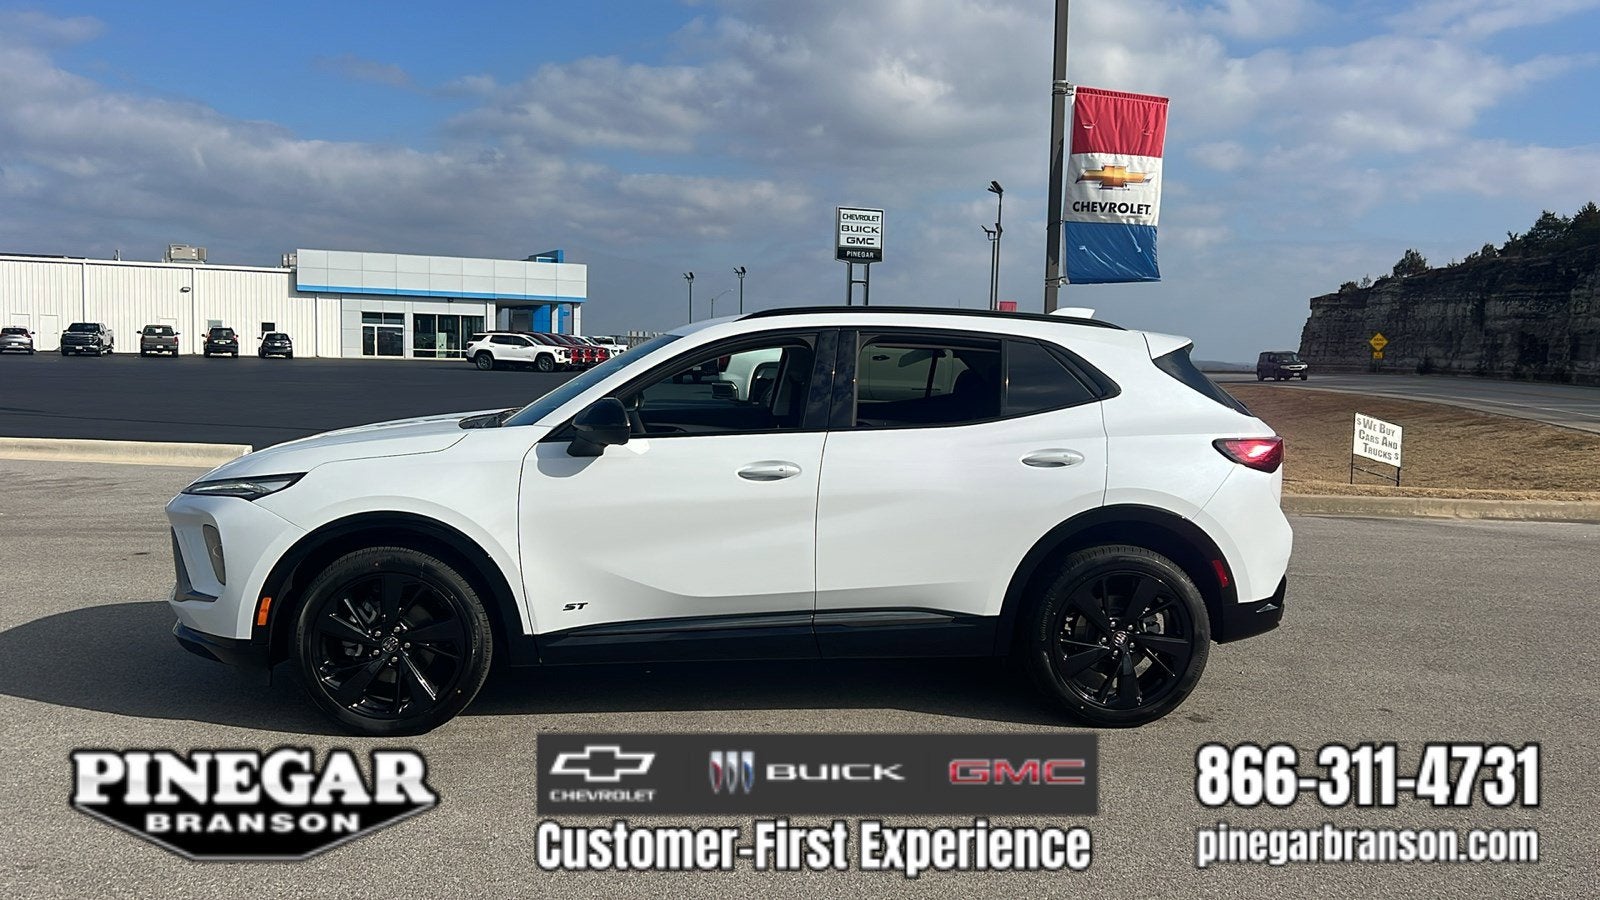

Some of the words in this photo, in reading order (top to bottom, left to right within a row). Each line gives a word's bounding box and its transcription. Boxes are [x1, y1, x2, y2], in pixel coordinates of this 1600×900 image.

[1072, 201, 1151, 215] CHEVROLET
[842, 213, 880, 222] CHEVROLET
[841, 225, 880, 234] BUICK
[846, 236, 875, 245] GMC
[846, 250, 874, 258] PINEGAR
[562, 602, 589, 611] ST
